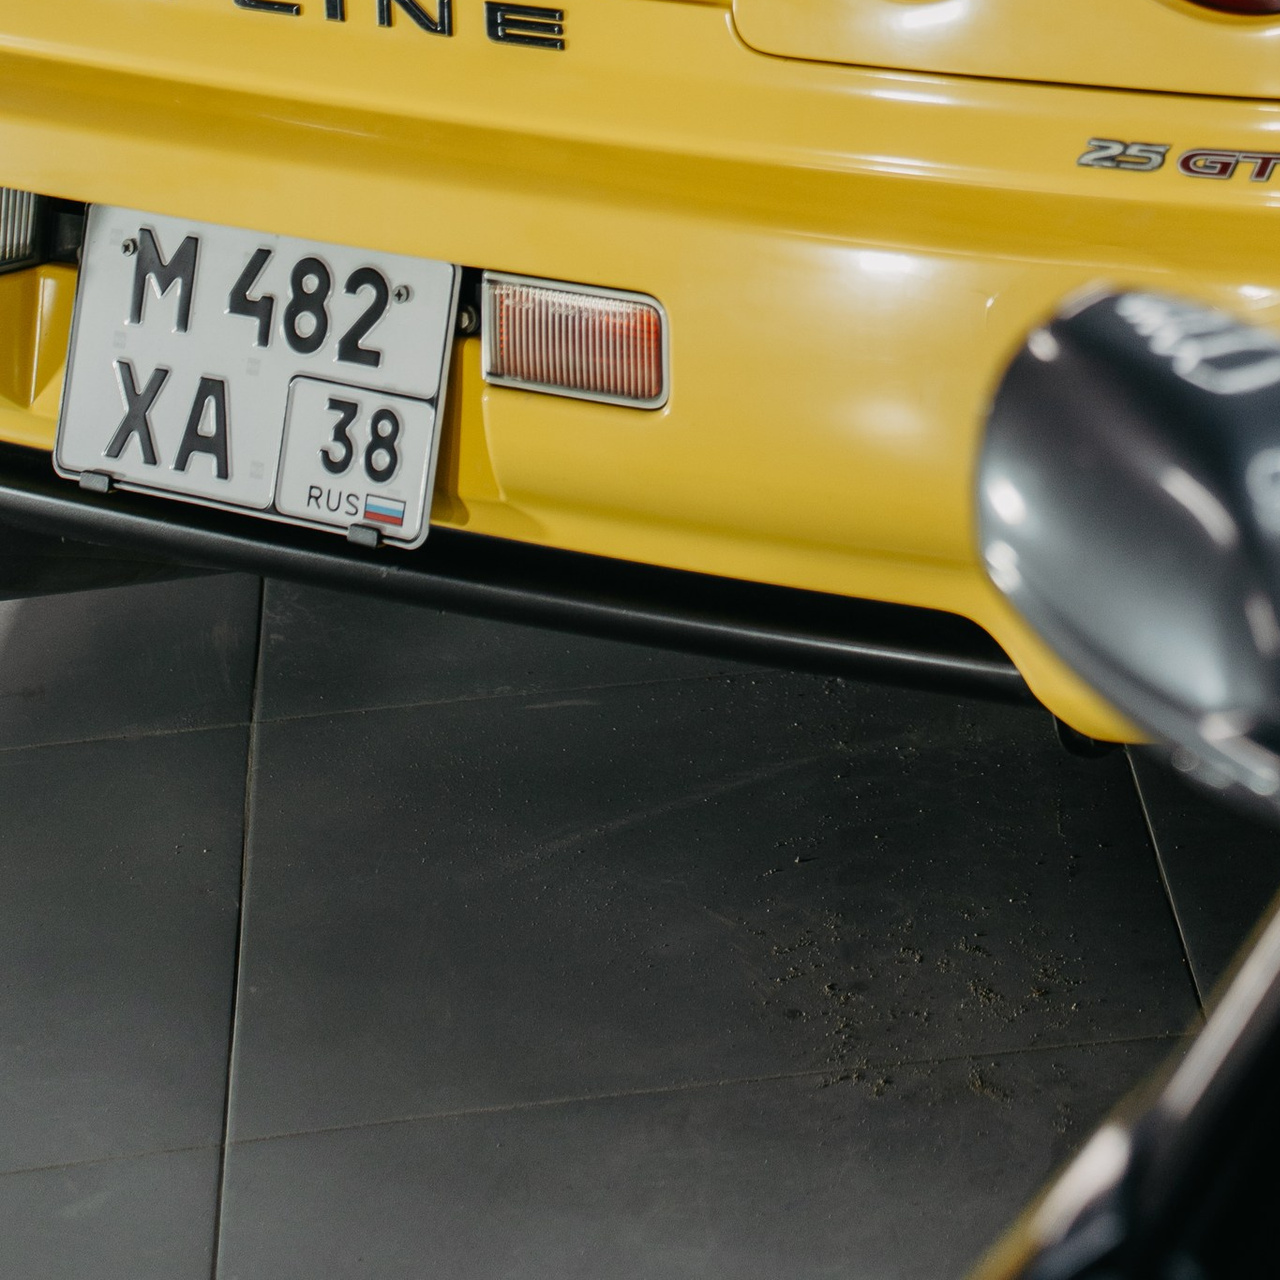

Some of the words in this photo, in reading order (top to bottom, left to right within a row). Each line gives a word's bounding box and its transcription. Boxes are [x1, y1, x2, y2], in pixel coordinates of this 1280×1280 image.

[1076, 137, 1171, 171] 25
[125, 226, 201, 334] M
[224, 246, 391, 369] 482
[102, 358, 230, 481] XA
[319, 396, 401, 484] 38
[306, 484, 360, 517] RUS
